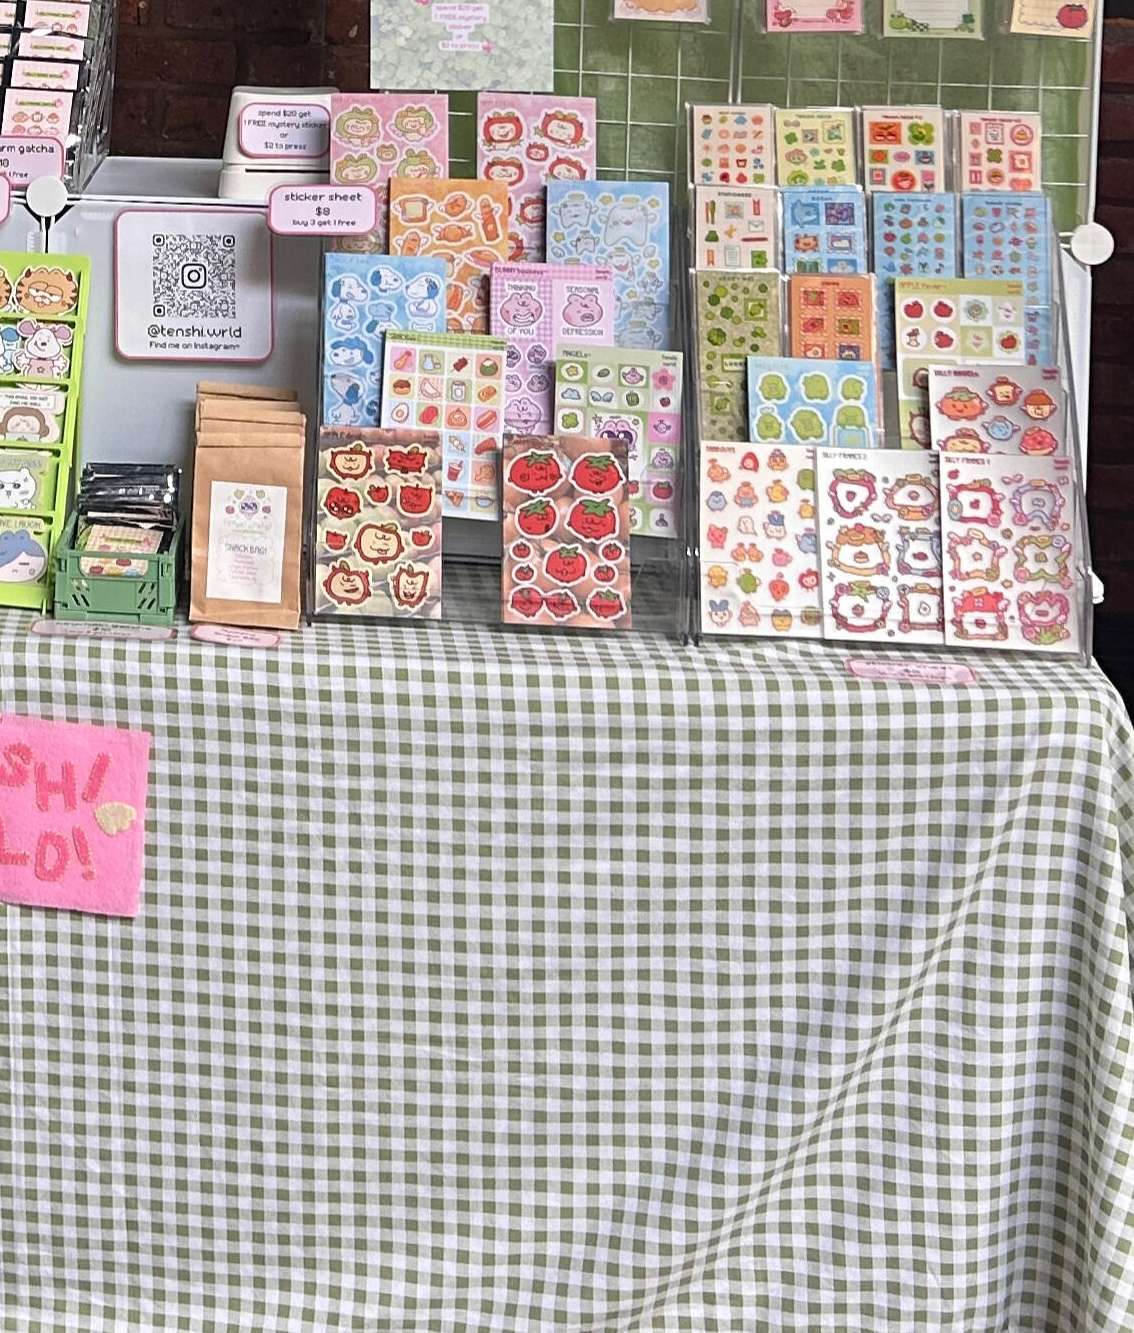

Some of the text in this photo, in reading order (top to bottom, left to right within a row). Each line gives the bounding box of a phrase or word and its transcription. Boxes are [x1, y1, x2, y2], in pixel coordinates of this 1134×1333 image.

[298, 110, 312, 118] get
[19, 145, 55, 154] gatcha
[284, 192, 362, 202] sticker sheet
[292, 219, 309, 227] buy
[317, 219, 332, 227] get
[147, 324, 242, 338] @tenshi.wrld
[562, 327, 604, 336] DEPRESSION
[14, 520, 41, 530] LAUGH
[225, 542, 249, 553] SNACK
